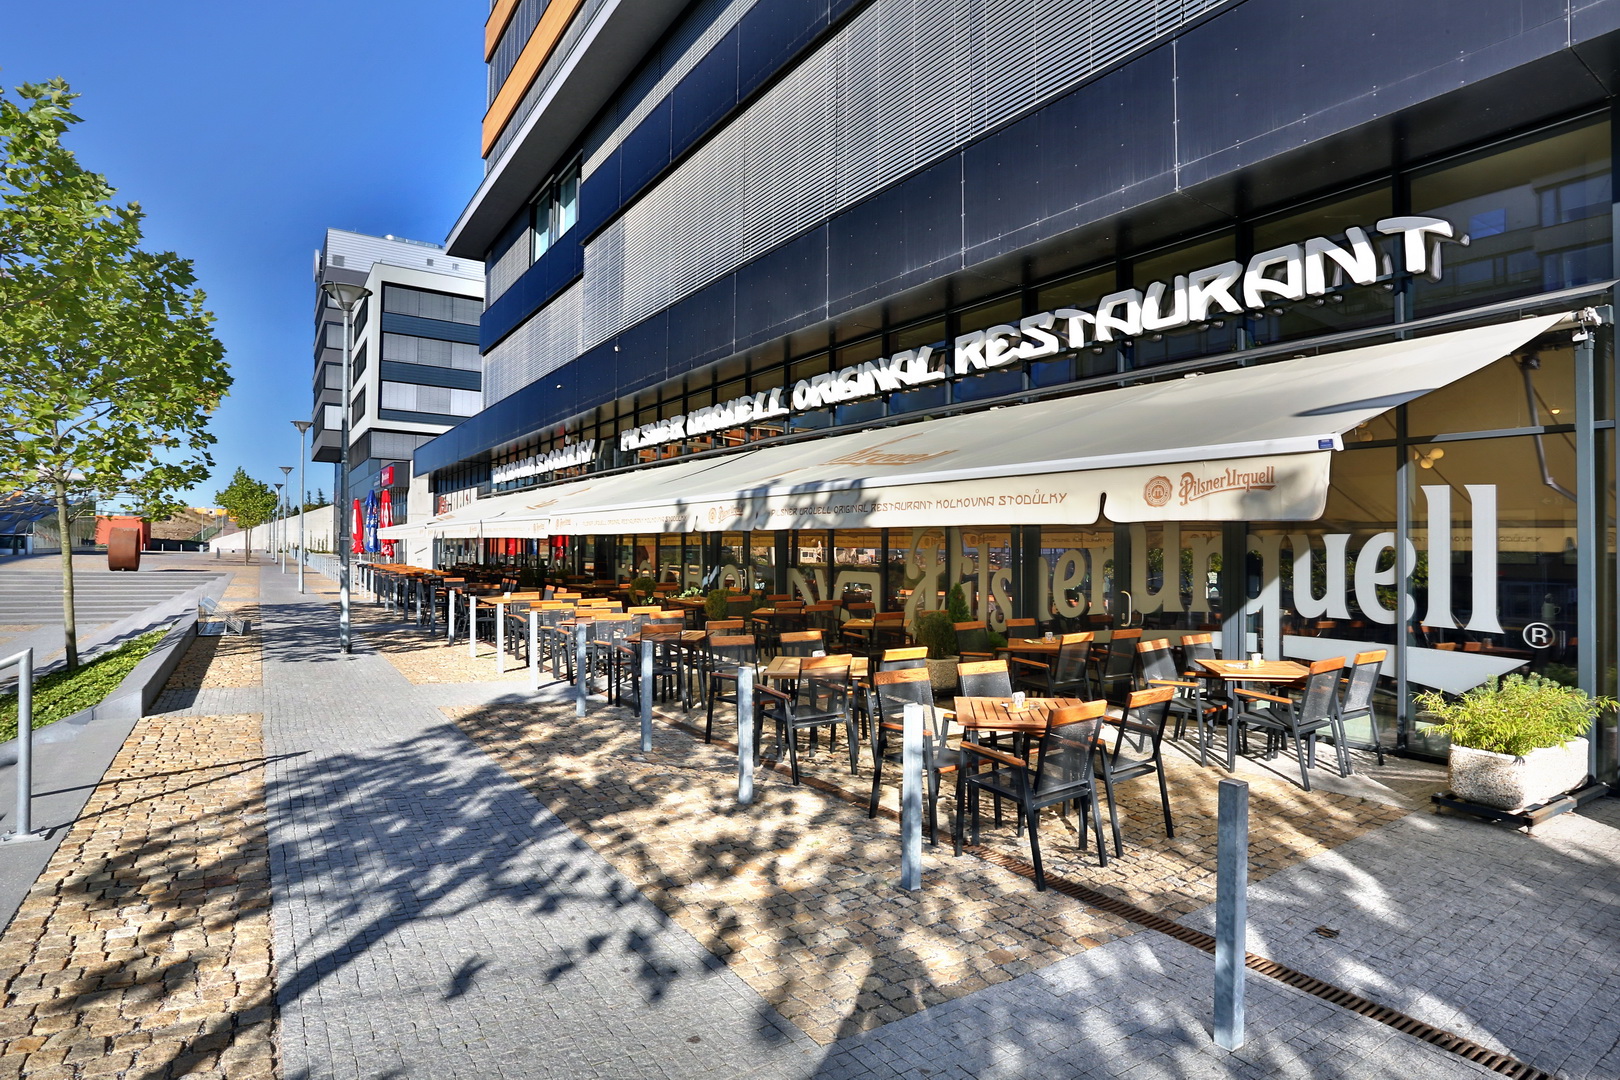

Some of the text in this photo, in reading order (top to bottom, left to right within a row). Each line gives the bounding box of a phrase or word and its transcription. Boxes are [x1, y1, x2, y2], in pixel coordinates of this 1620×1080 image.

[687, 387, 789, 435] URQUELL
[793, 345, 945, 410] ORIGINAL
[954, 216, 1455, 374] RESTAURANT
[799, 506, 831, 515] URQUELL
[833, 503, 868, 513] ORIGINAL
[871, 499, 934, 513] RESTAURANT
[935, 496, 995, 509] KOLKOVNA
[998, 488, 1068, 506] STODŮLKY
[1178, 471, 1226, 506] Pilsner
[1225, 466, 1275, 492] Urquell
